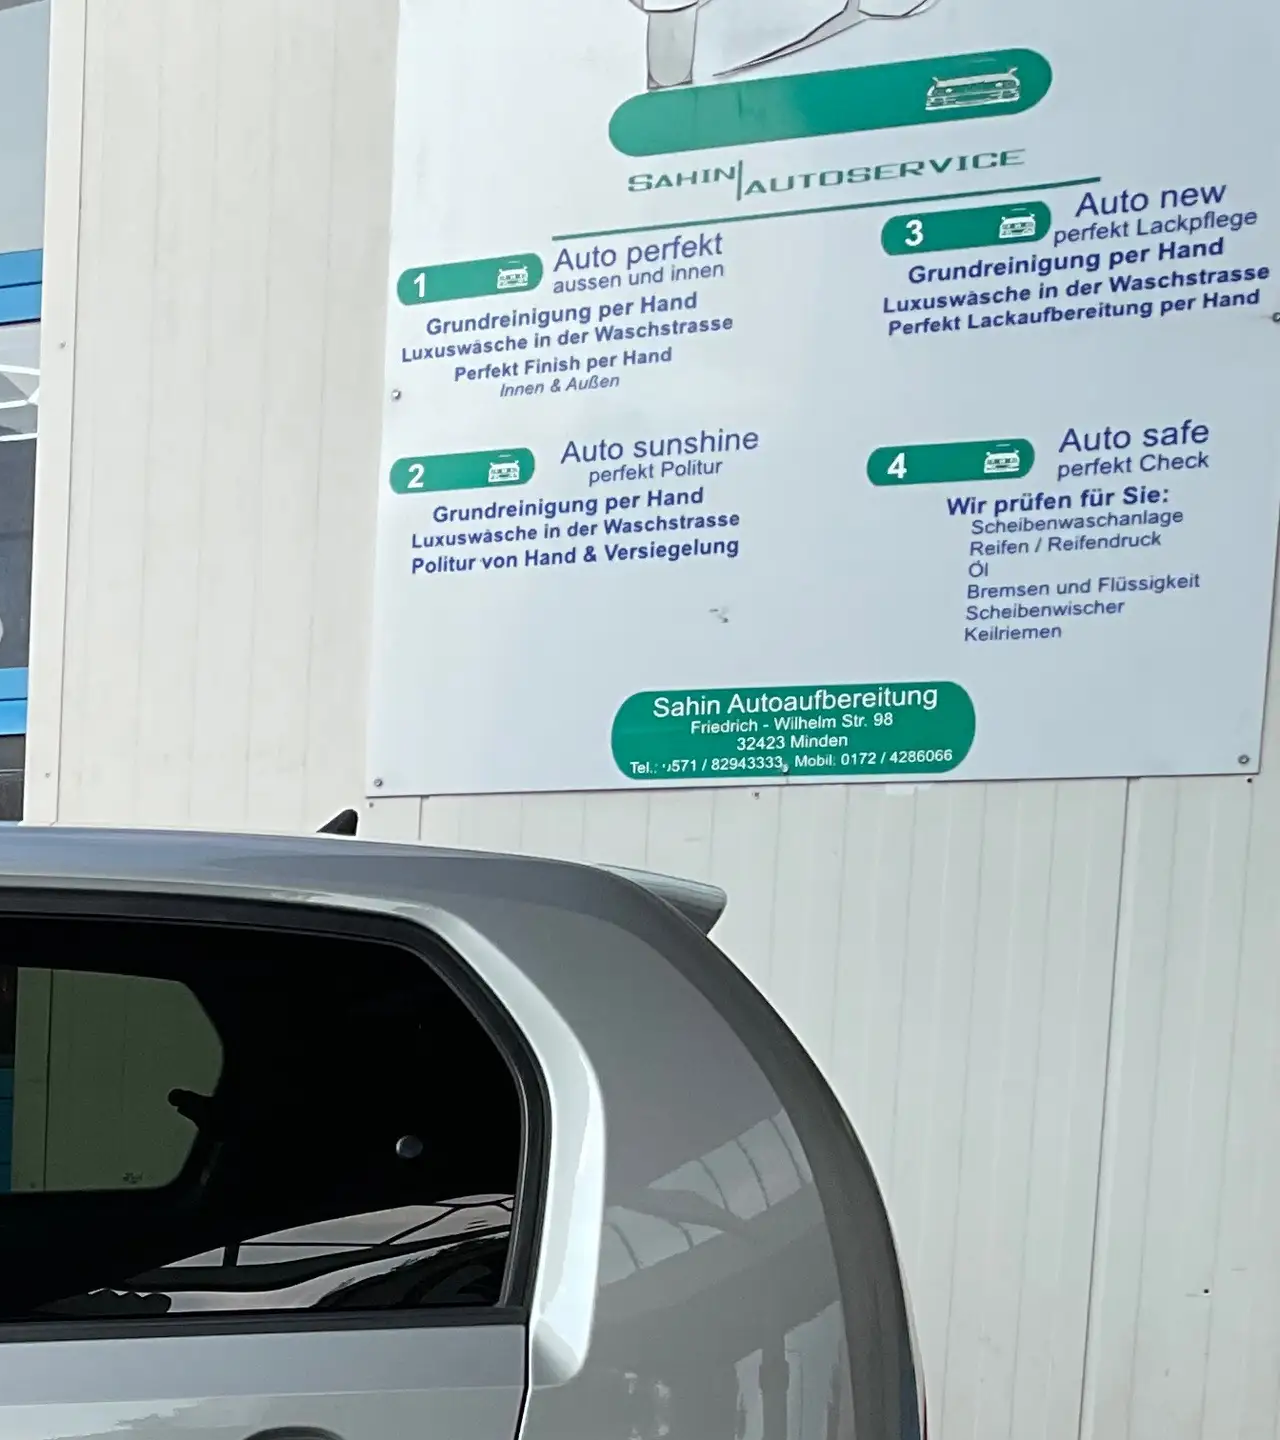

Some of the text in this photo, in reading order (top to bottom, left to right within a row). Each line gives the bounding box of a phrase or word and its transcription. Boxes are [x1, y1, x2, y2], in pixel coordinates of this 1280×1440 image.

[628, 149, 1026, 196] SAHIN AUTOSERVICE
[1075, 185, 1226, 217] Auto new
[905, 220, 924, 246] 3
[1054, 211, 1257, 247] perfekt Lackpflege
[553, 233, 723, 272] Auto perfekt
[908, 237, 1224, 284] Grundreinigung per Hand
[414, 273, 426, 298] 1
[553, 263, 724, 293] aussen und innen
[883, 267, 1270, 312] Luxuswäsche in der Waschstrasse
[426, 292, 697, 335] Grundreinigung per Hand
[889, 289, 1260, 335] Perfekt Lackaufbereitung per Hand
[402, 317, 733, 362] Luxuswäsche in der Waschstrasse
[455, 346, 672, 381] Perfekt Finish per Hand
[500, 375, 620, 397] Innen & Außen
[561, 429, 759, 464] Auto sunshine
[1059, 420, 1209, 452] Auto safe
[407, 464, 424, 488] 2
[589, 460, 723, 486] perfekt Politur
[887, 453, 907, 479] 4
[1057, 452, 1209, 481] perfekt Check
[433, 488, 704, 523] Grundreinigung per Hand
[947, 486, 1169, 516] Wir prüfen für Sie:
[412, 513, 740, 549] Luxuswäsche in der Waschstrasse
[972, 510, 1183, 535] Scheibenwaschanlage
[412, 538, 739, 574] Politur von Hand & Versiegelung
[970, 532, 1161, 556] Reifen / Reifendruck
[969, 560, 988, 578] Öl
[967, 574, 1200, 599] Bremsen und Flüssigkeit
[966, 601, 1124, 621] Scheibenwischer
[965, 626, 1062, 642] Keilriemen
[653, 687, 938, 718] Sahin Autoaufbereitung
[691, 719, 757, 734] Friedrich
[774, 716, 836, 731] Wilhelm
[842, 714, 868, 728] Str.
[874, 713, 893, 726] 98
[737, 735, 848, 751] 32423 Minden
[795, 754, 836, 768] Mobil:
[841, 752, 876, 766] 0172
[889, 749, 953, 763] 4286066
